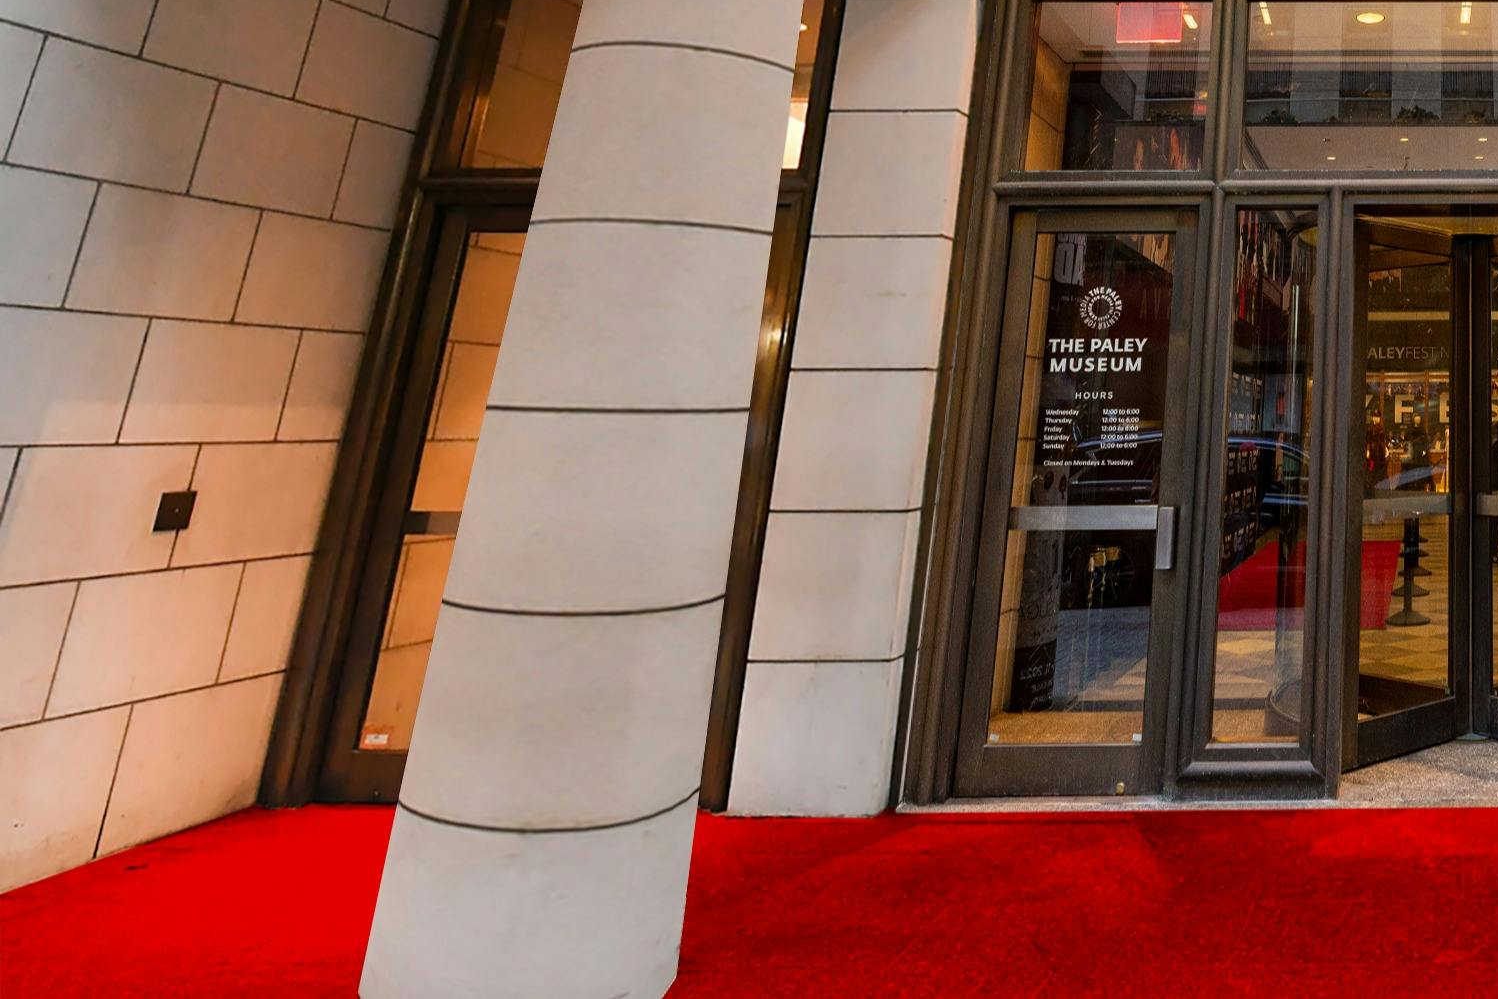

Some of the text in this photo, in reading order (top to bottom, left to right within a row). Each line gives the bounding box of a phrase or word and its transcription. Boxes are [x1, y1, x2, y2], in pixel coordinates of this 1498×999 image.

[1088, 286, 1105, 297] THE
[1105, 288, 1123, 311] PALEY
[1048, 338, 1148, 353] THE PALEY
[1367, 346, 1436, 360] ALEYFEST
[1050, 357, 1142, 373] MUSEUM
[1075, 391, 1113, 400] HOURS
[1045, 408, 1080, 417] Wednesday
[1044, 417, 1073, 425] Thursday
[1043, 425, 1063, 433] Friday
[1043, 434, 1070, 442] Saturday
[1073, 459, 1100, 467] Mondays
